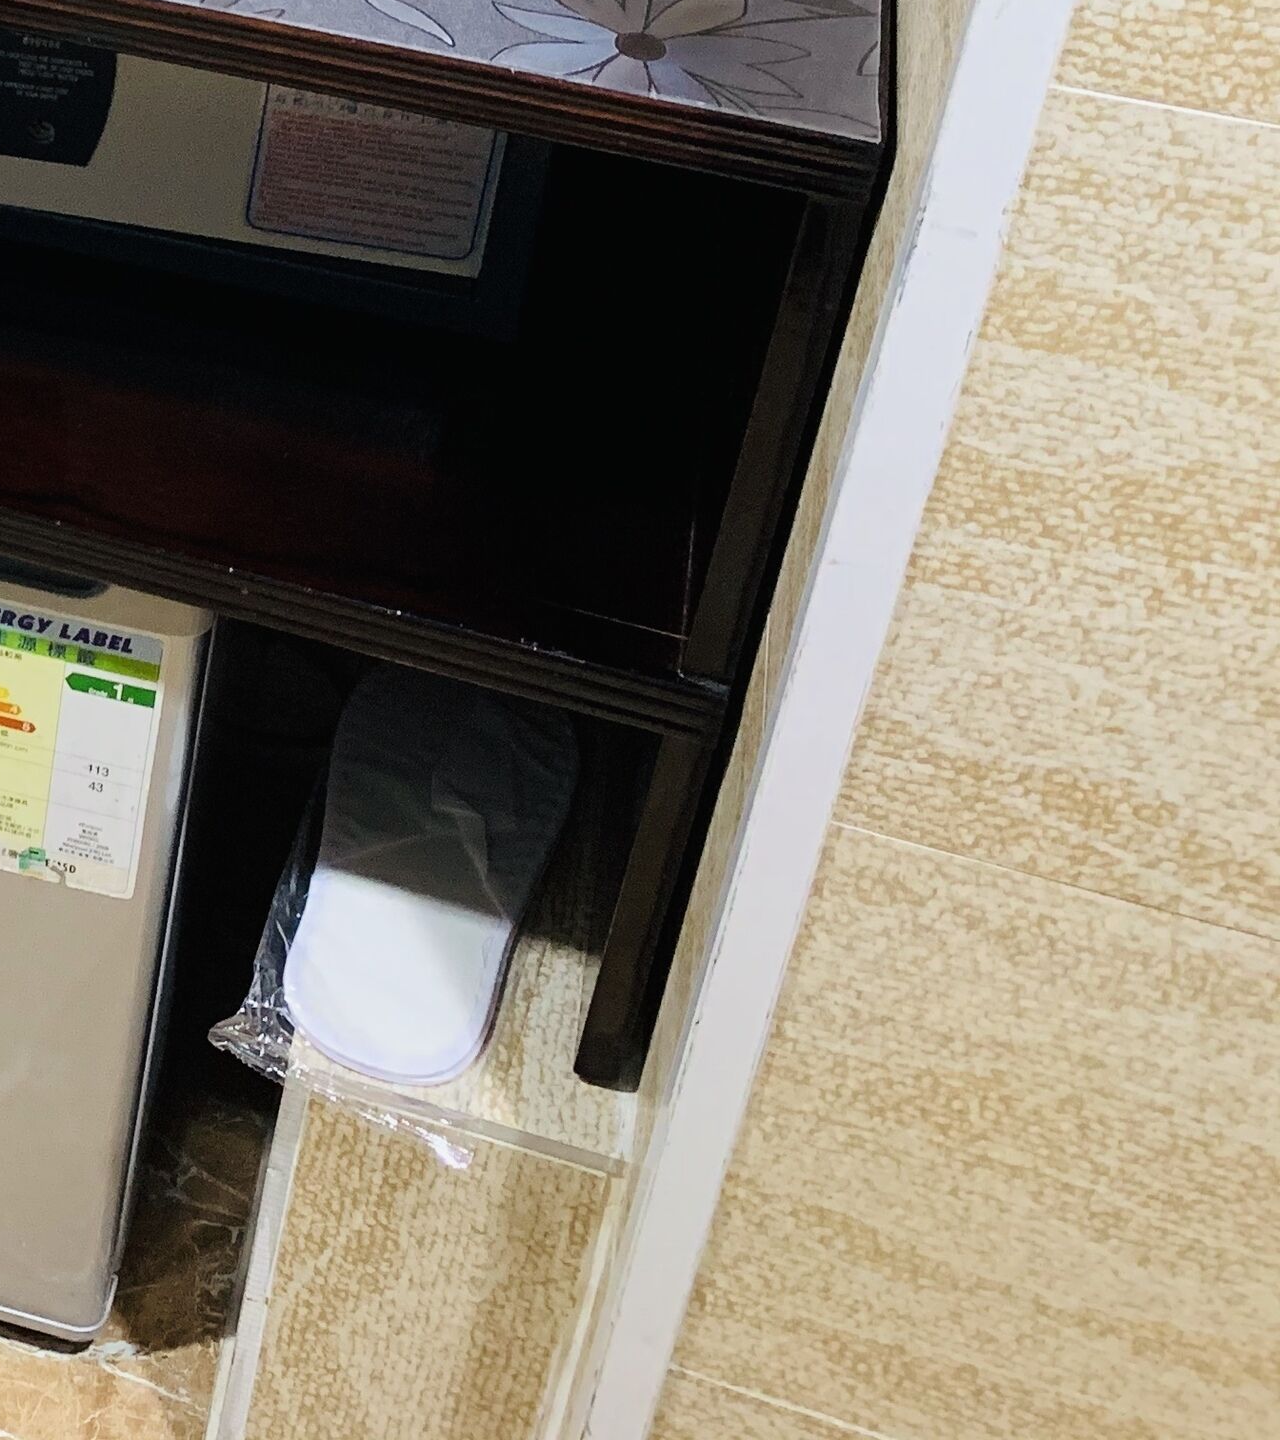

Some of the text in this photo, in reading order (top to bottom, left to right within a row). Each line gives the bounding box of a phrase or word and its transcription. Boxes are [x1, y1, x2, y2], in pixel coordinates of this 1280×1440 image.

[59, 623, 133, 654] LABEL
[113, 683, 124, 701] 1
[88, 763, 110, 777] 113
[88, 781, 104, 793] 43
